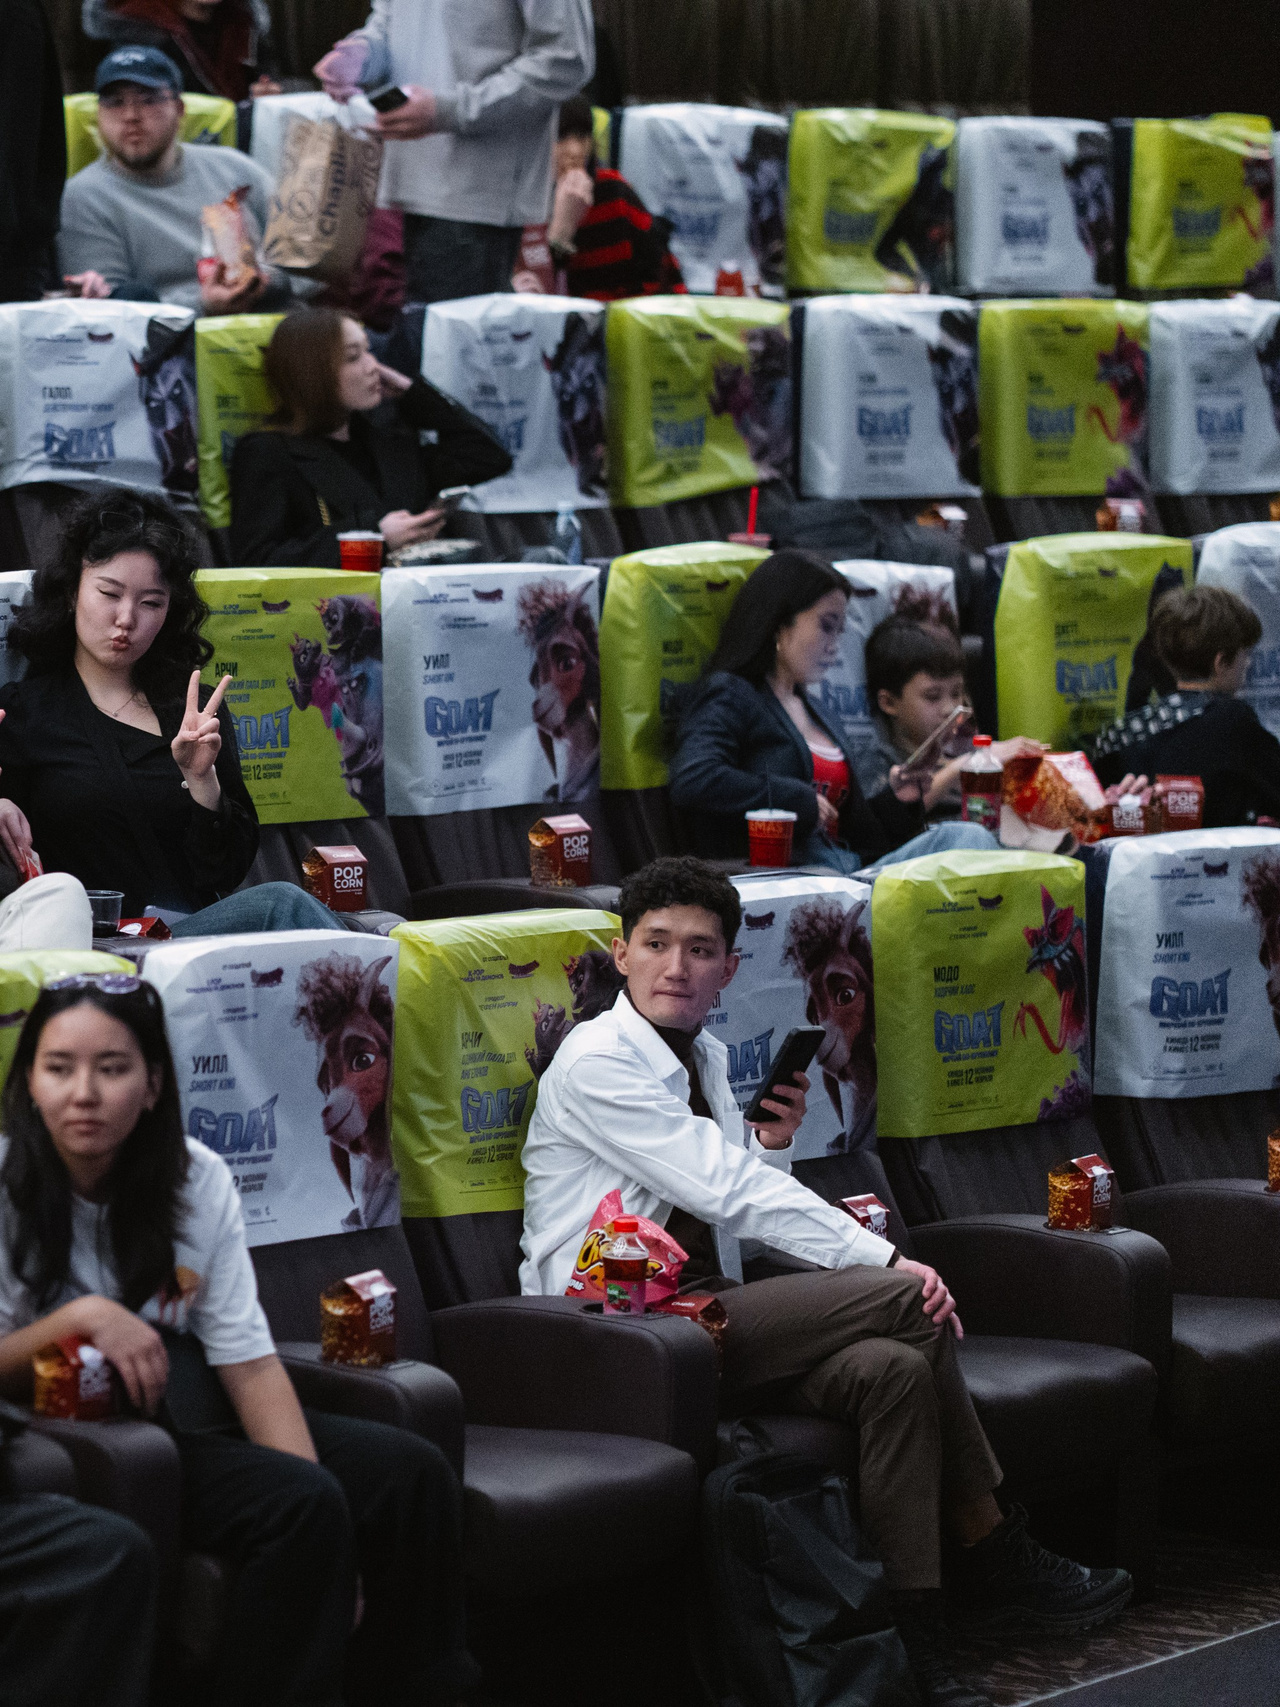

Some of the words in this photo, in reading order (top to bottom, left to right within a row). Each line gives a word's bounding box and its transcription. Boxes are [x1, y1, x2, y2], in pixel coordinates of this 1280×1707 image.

[215, 662, 238, 678] АРЧИ
[424, 688, 501, 738] GOAT
[252, 764, 262, 780] 12
[563, 835, 589, 849] POP
[564, 848, 589, 858] CORN
[333, 866, 363, 880] POP
[334, 878, 363, 890] CORN
[1156, 931, 1184, 949] УИЛЛ
[933, 965, 960, 983] МОДО
[1149, 967, 1231, 1022] GOAT
[715, 1012, 728, 1024] KING
[934, 1000, 1006, 1054] GOAT
[1189, 1035, 1199, 1053] 12
[192, 1054, 228, 1075] УИЛЛ
[964, 1068, 974, 1085] 12
[460, 1078, 535, 1133] GOAT
[187, 1093, 279, 1154] GOAT
[487, 1146, 496, 1164] 12
[1093, 1179, 1111, 1194] POP
[1093, 1193, 1111, 1204] CORN
